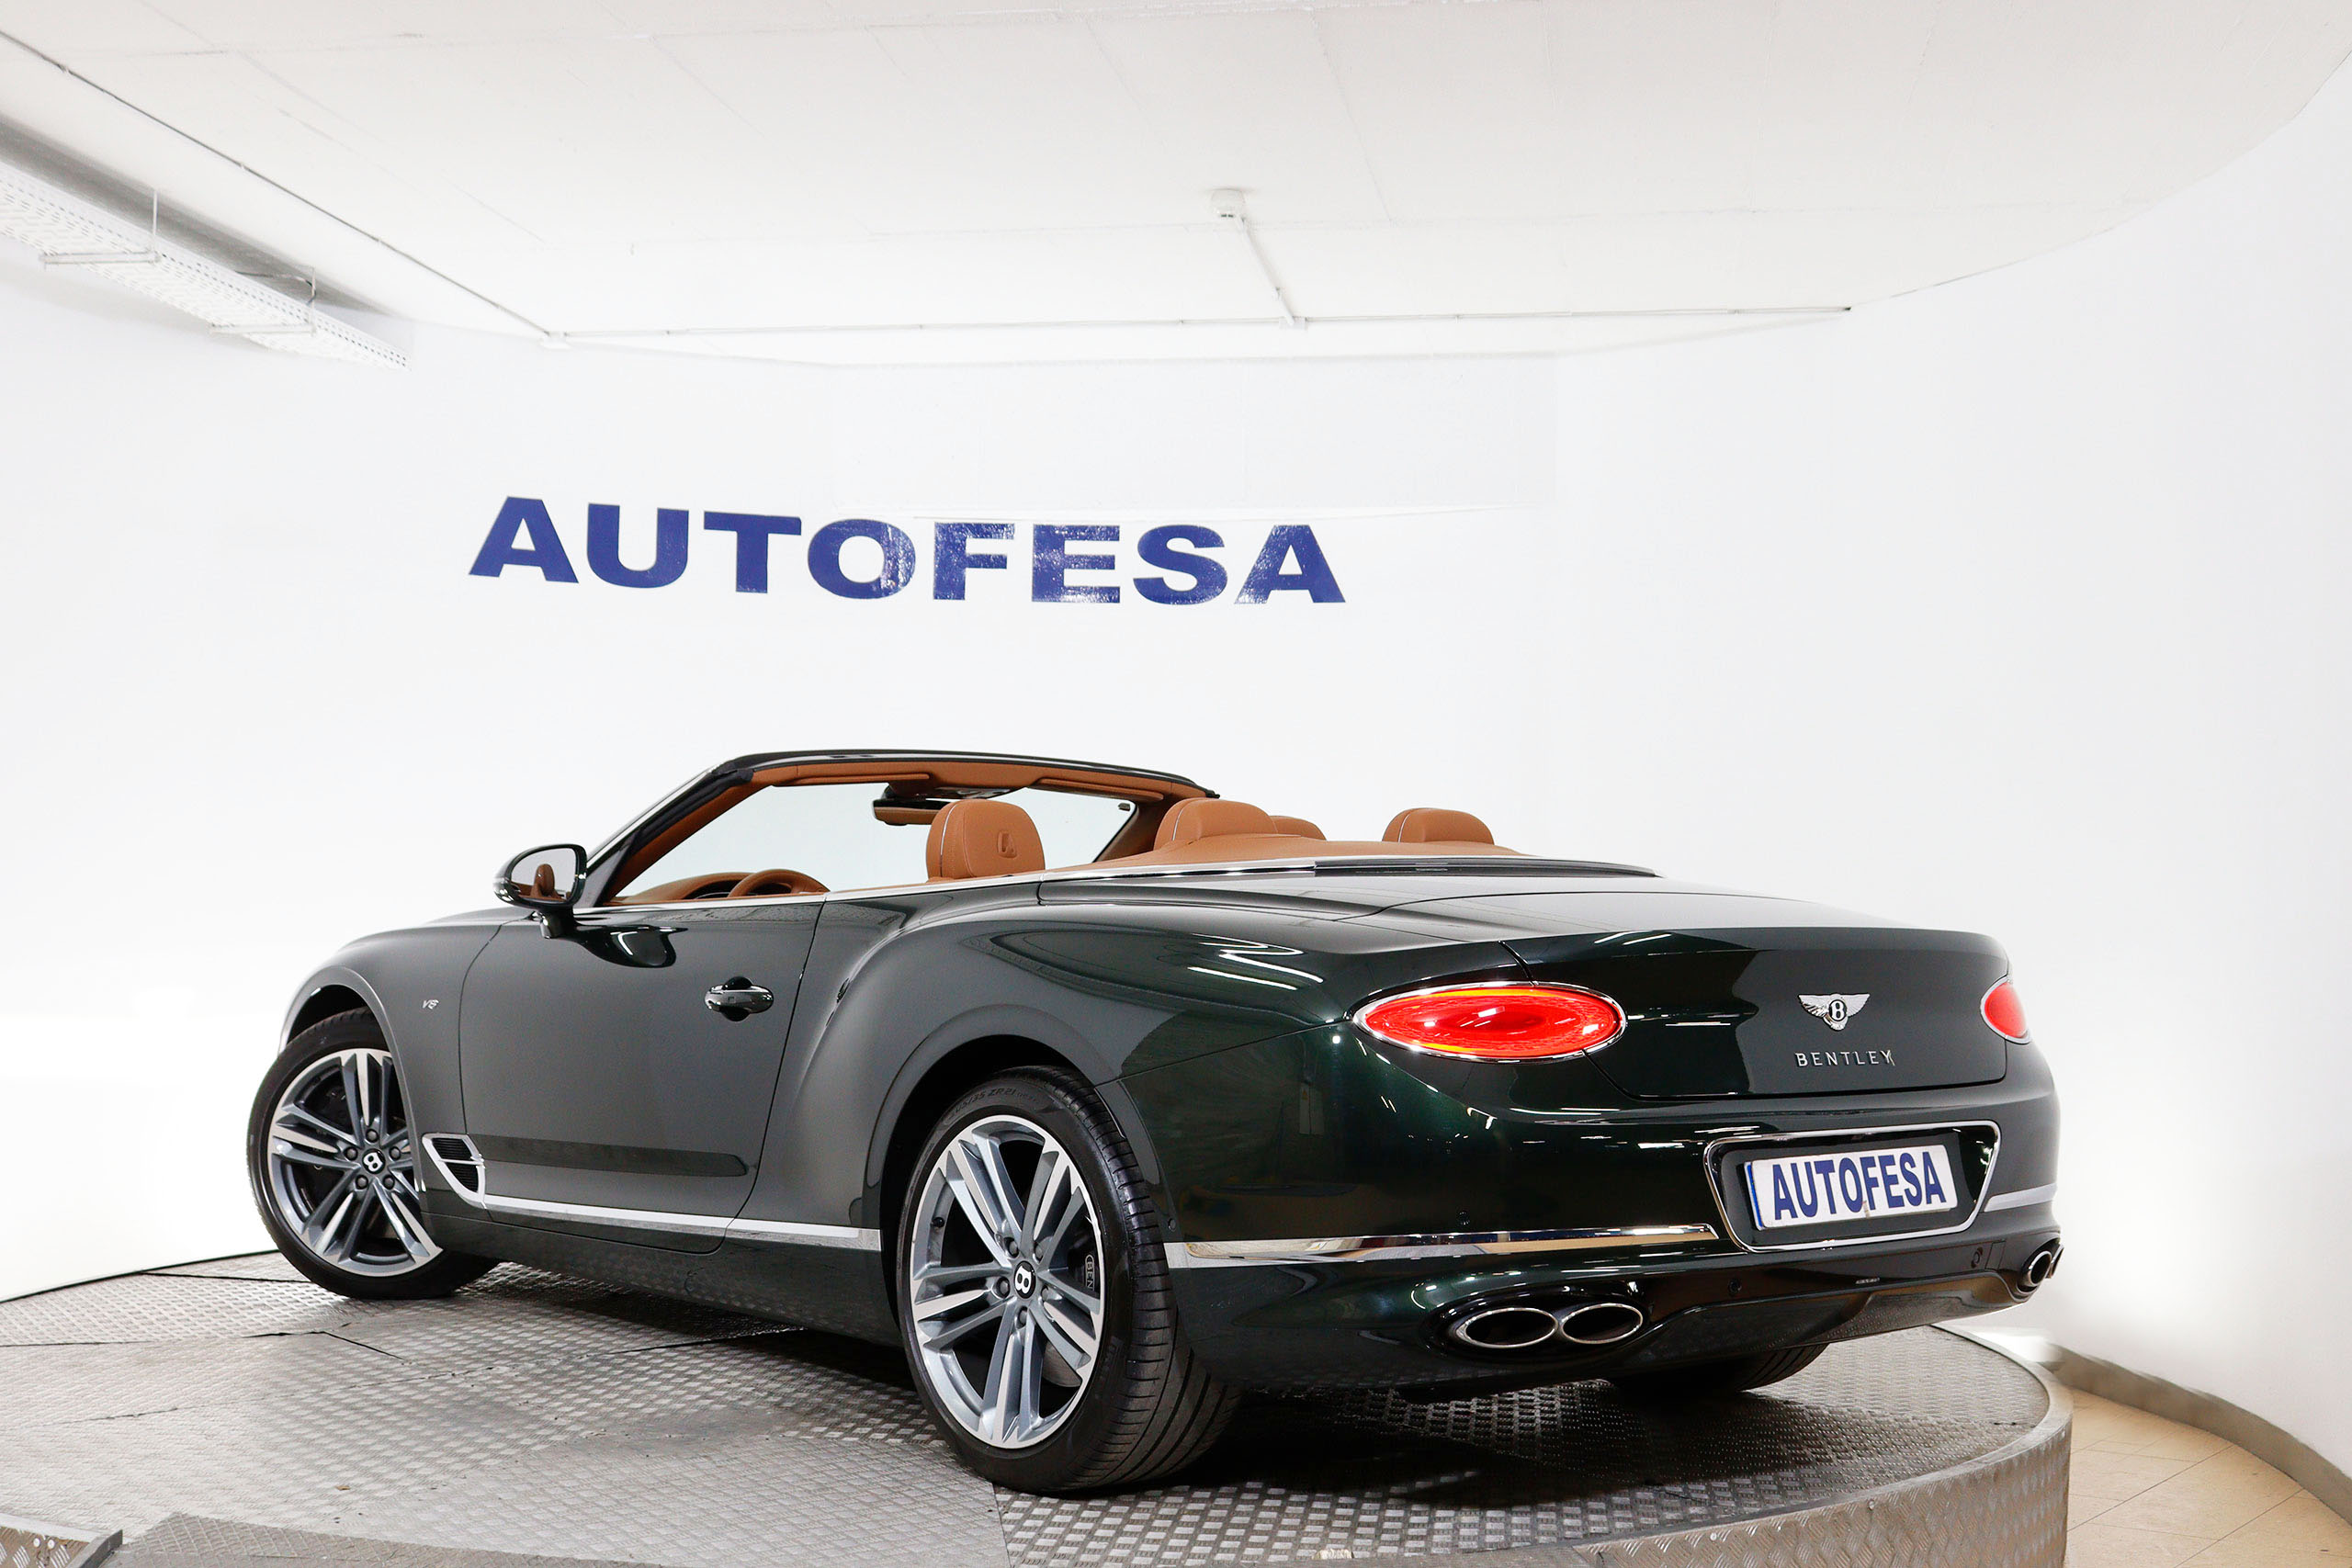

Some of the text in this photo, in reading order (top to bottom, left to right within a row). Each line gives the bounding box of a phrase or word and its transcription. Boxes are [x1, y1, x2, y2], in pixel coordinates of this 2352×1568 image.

[468, 497, 1346, 605] AUTOFESA
[1795, 1050, 1896, 1067] BENTLEY
[1773, 1151, 1947, 1221] AUTOFESA
